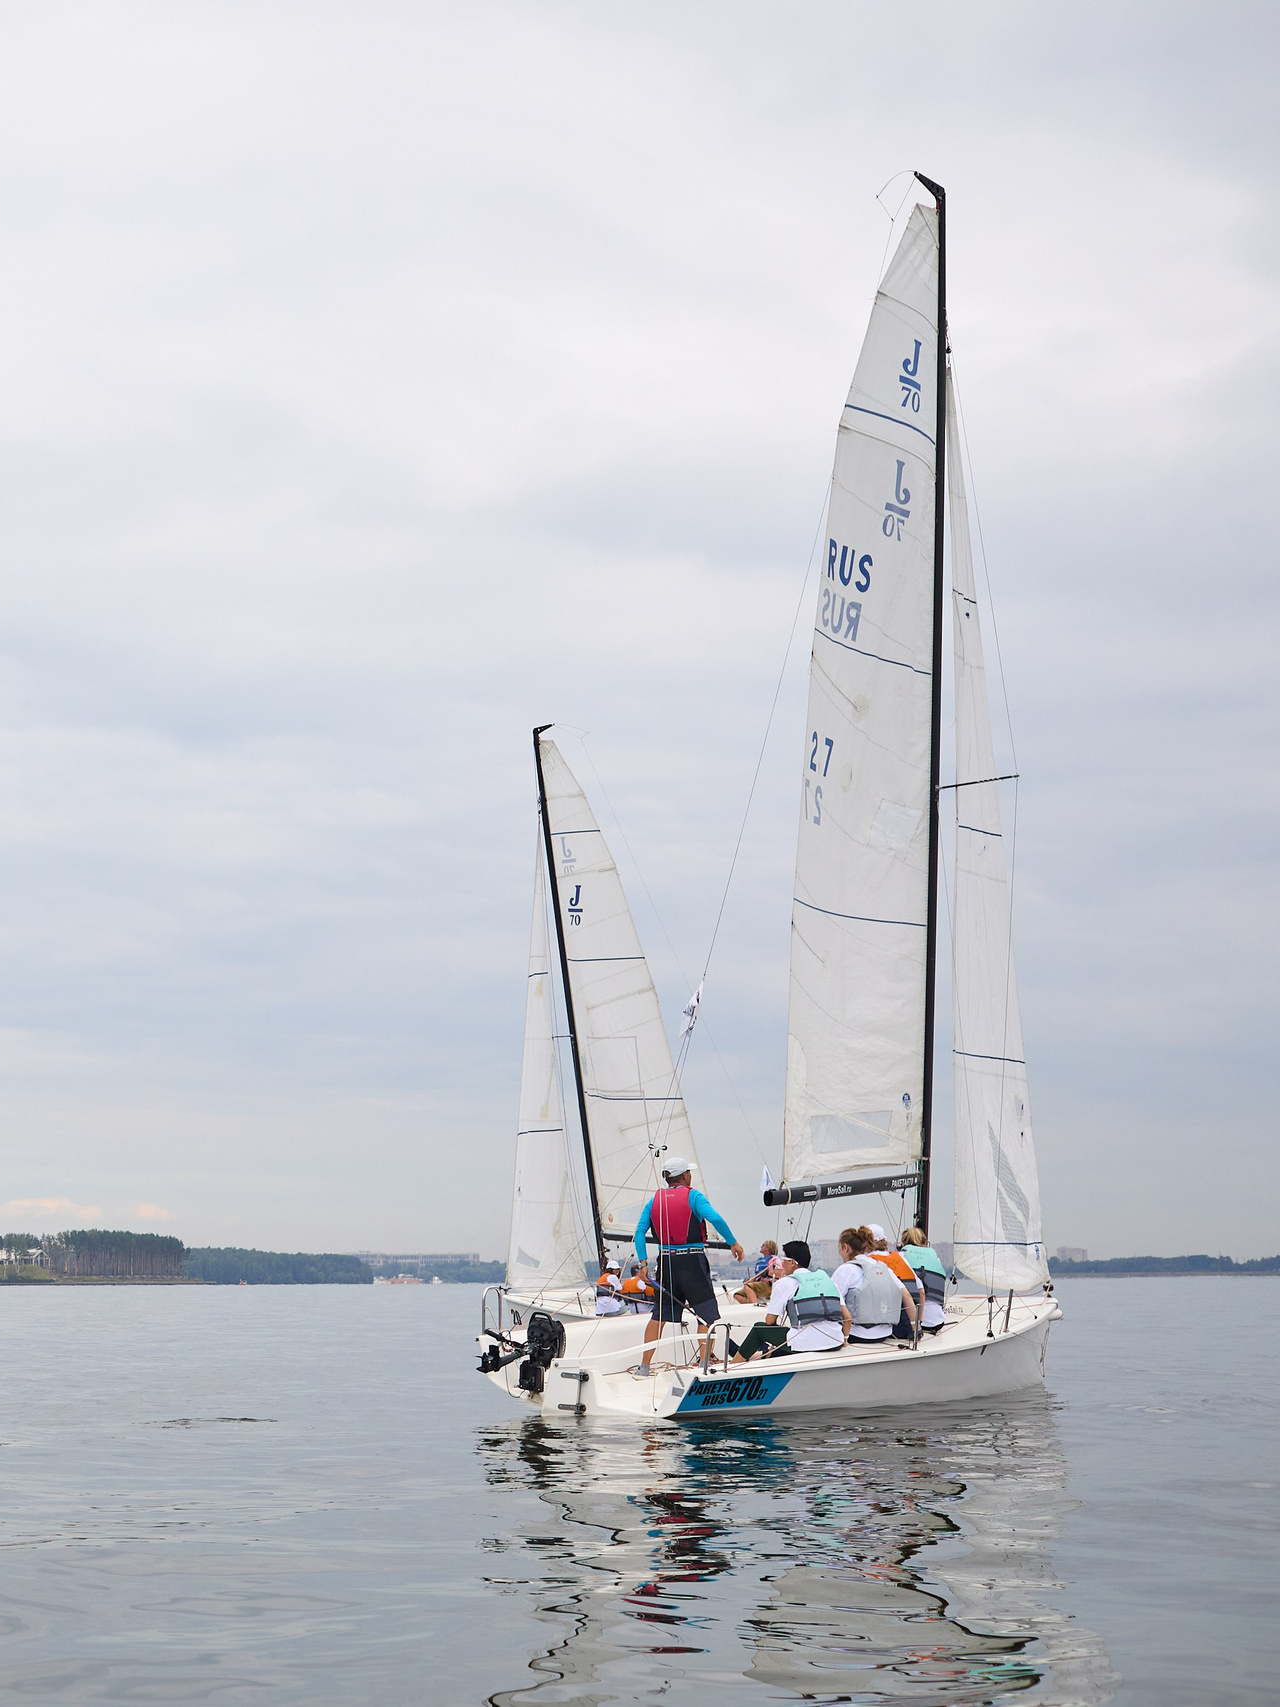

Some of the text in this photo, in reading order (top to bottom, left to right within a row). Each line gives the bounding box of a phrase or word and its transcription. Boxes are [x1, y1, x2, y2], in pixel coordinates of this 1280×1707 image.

[901, 339, 922, 377] J
[901, 386, 921, 413] 70
[827, 538, 873, 593] RUS
[809, 731, 834, 777] 27
[569, 885, 581, 906] J
[570, 914, 581, 926] 70
[702, 1394, 727, 1406] RUS
[726, 1377, 763, 1403] 670
[757, 1388, 768, 1400] 27
